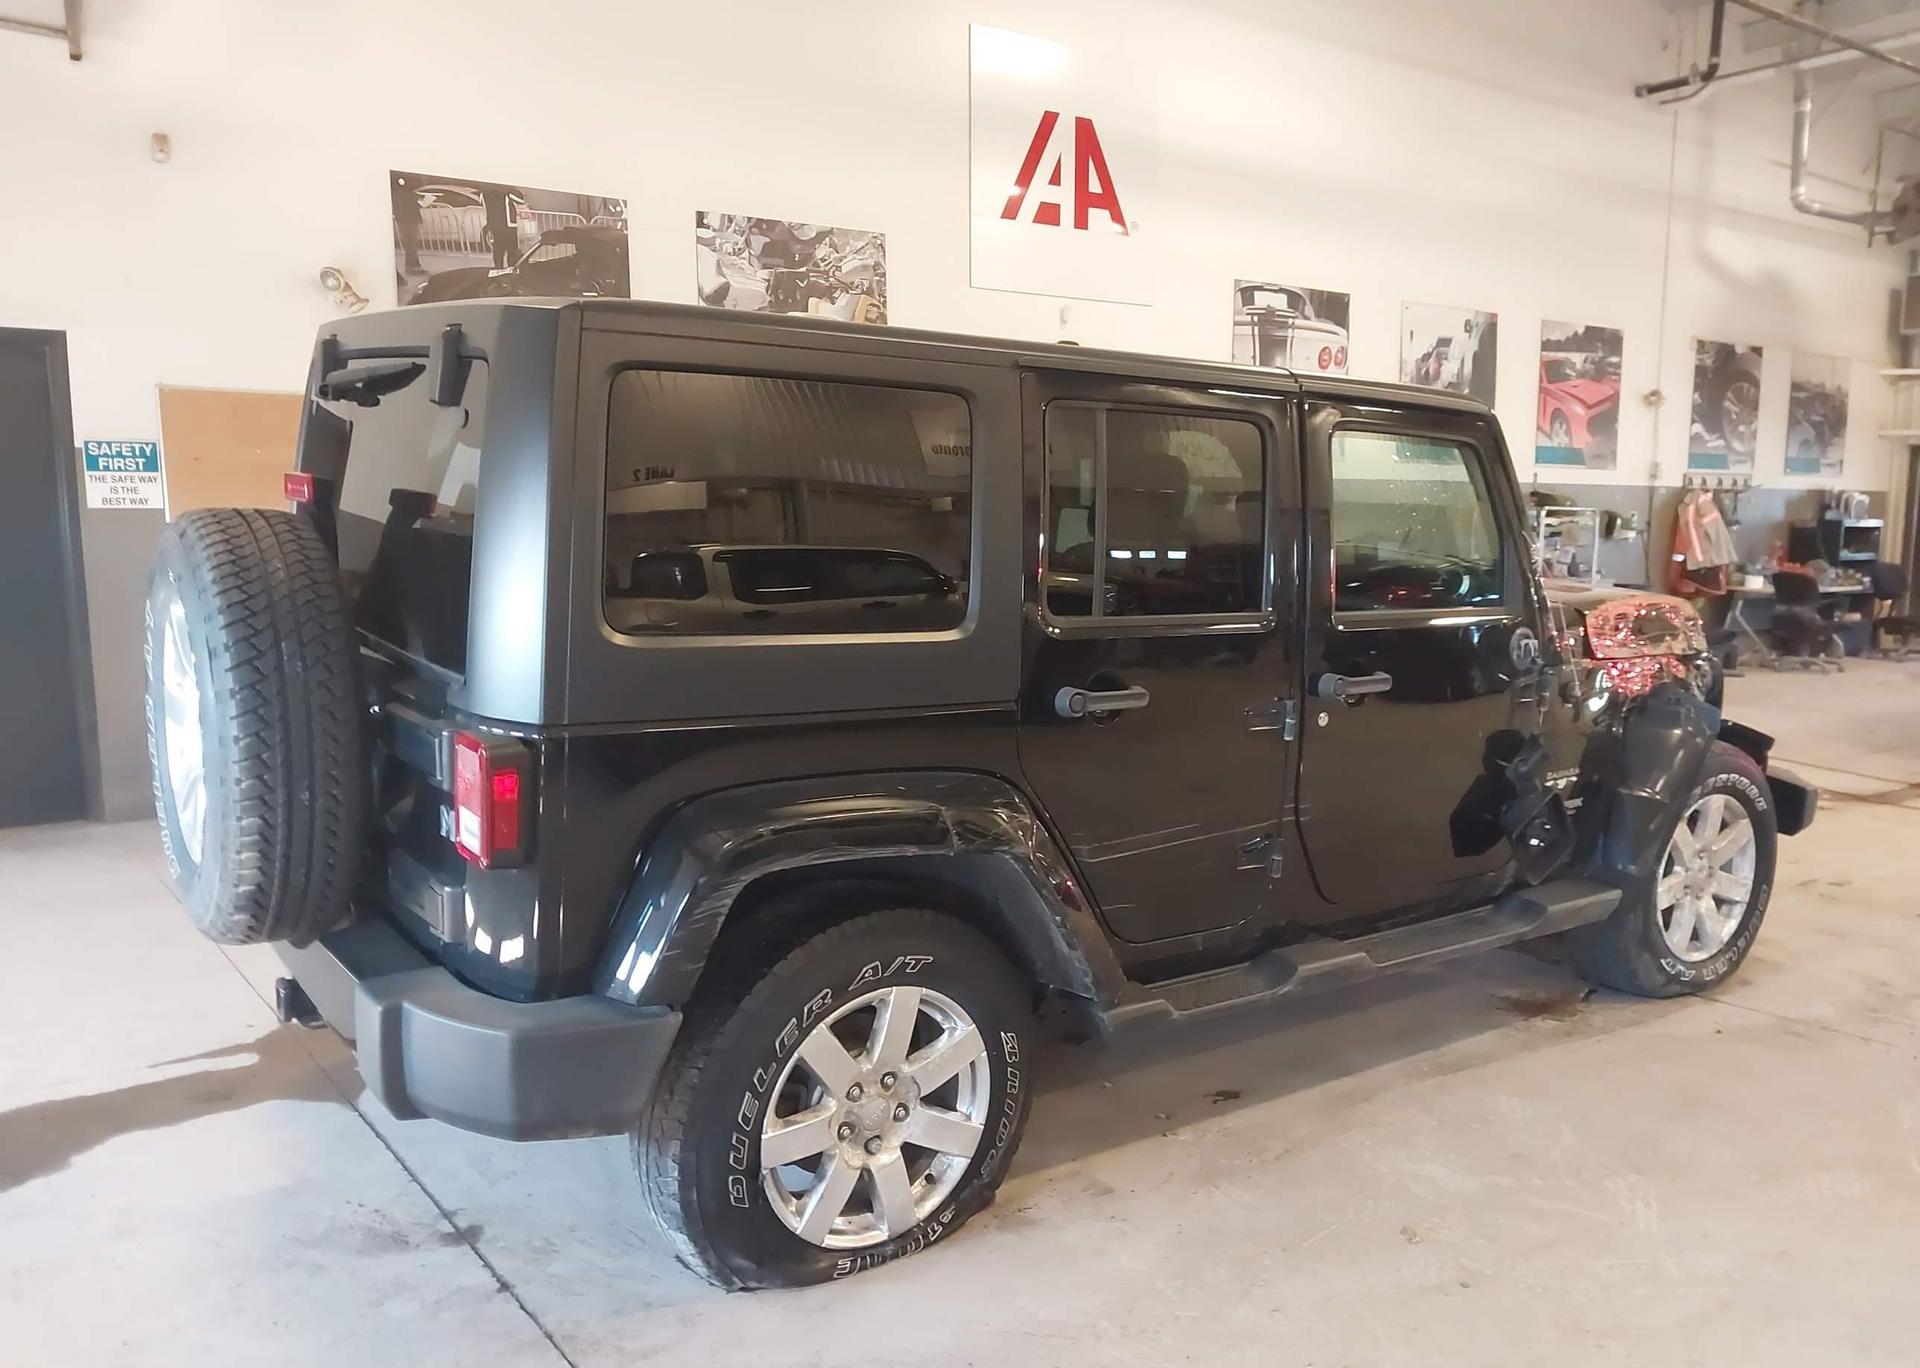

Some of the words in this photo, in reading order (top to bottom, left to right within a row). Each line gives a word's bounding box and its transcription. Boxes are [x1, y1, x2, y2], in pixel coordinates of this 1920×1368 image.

[88, 442, 152, 456] SAFETY
[98, 458, 146, 471] FIRST
[88, 474, 108, 483] THE
[111, 475, 136, 484] SAFE
[139, 475, 158, 484] WAY
[110, 486, 119, 495] IS
[121, 486, 140, 495] THE
[101, 497, 126, 506] BEST
[129, 497, 149, 506] WAY
[728, 988, 833, 1209] DUELER
[848, 956, 934, 991] A/T
